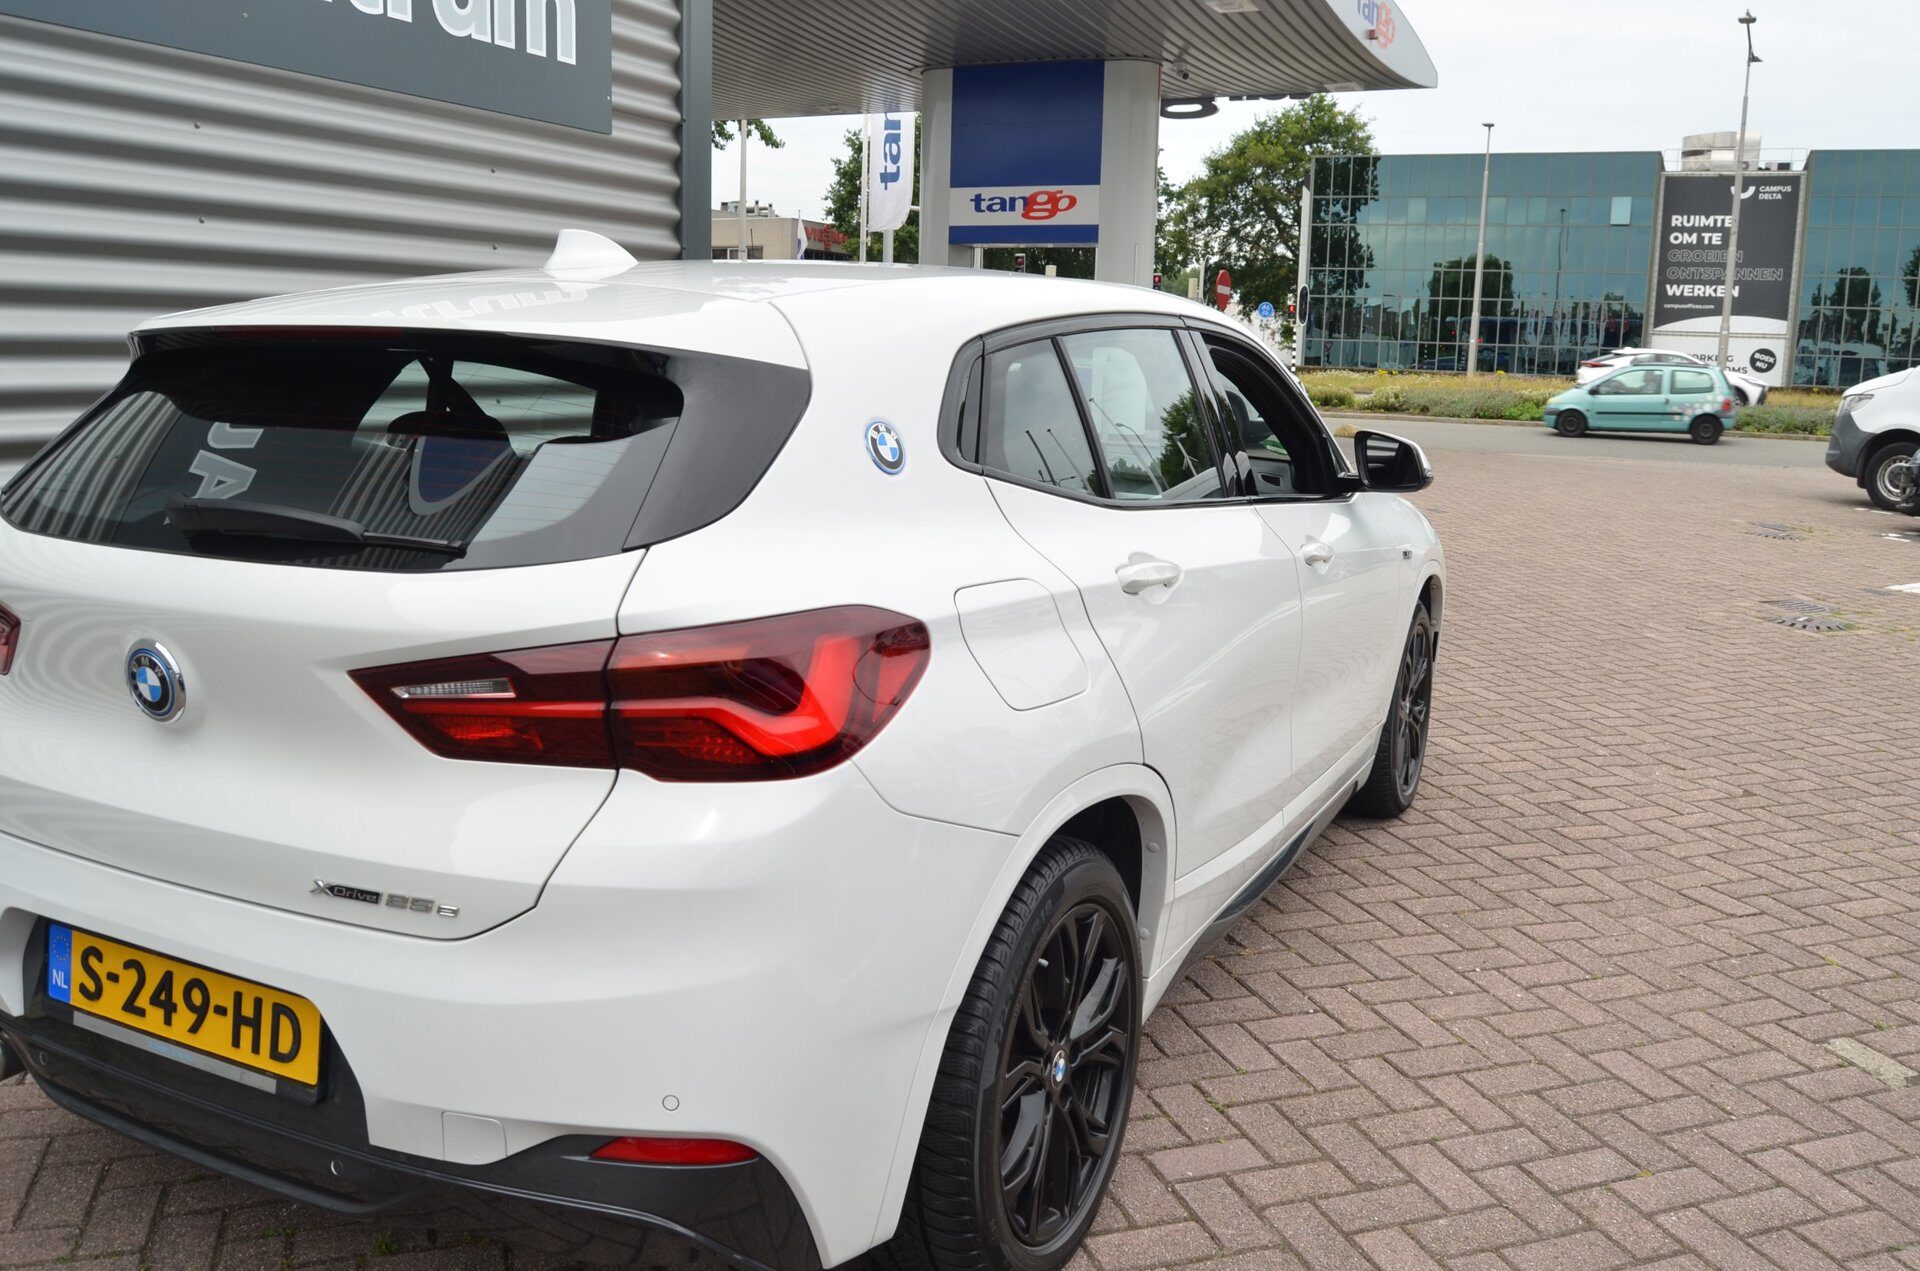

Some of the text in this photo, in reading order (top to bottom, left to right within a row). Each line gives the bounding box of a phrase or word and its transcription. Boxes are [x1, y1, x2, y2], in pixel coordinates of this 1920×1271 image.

[1759, 185, 1792, 193] CAMPUS
[970, 190, 1077, 220] tango
[1671, 214, 1733, 228] RUIMTE
[1669, 232, 1722, 245] OM TE
[52, 969, 69, 990] NL
[79, 945, 302, 1064] S-249-HD
